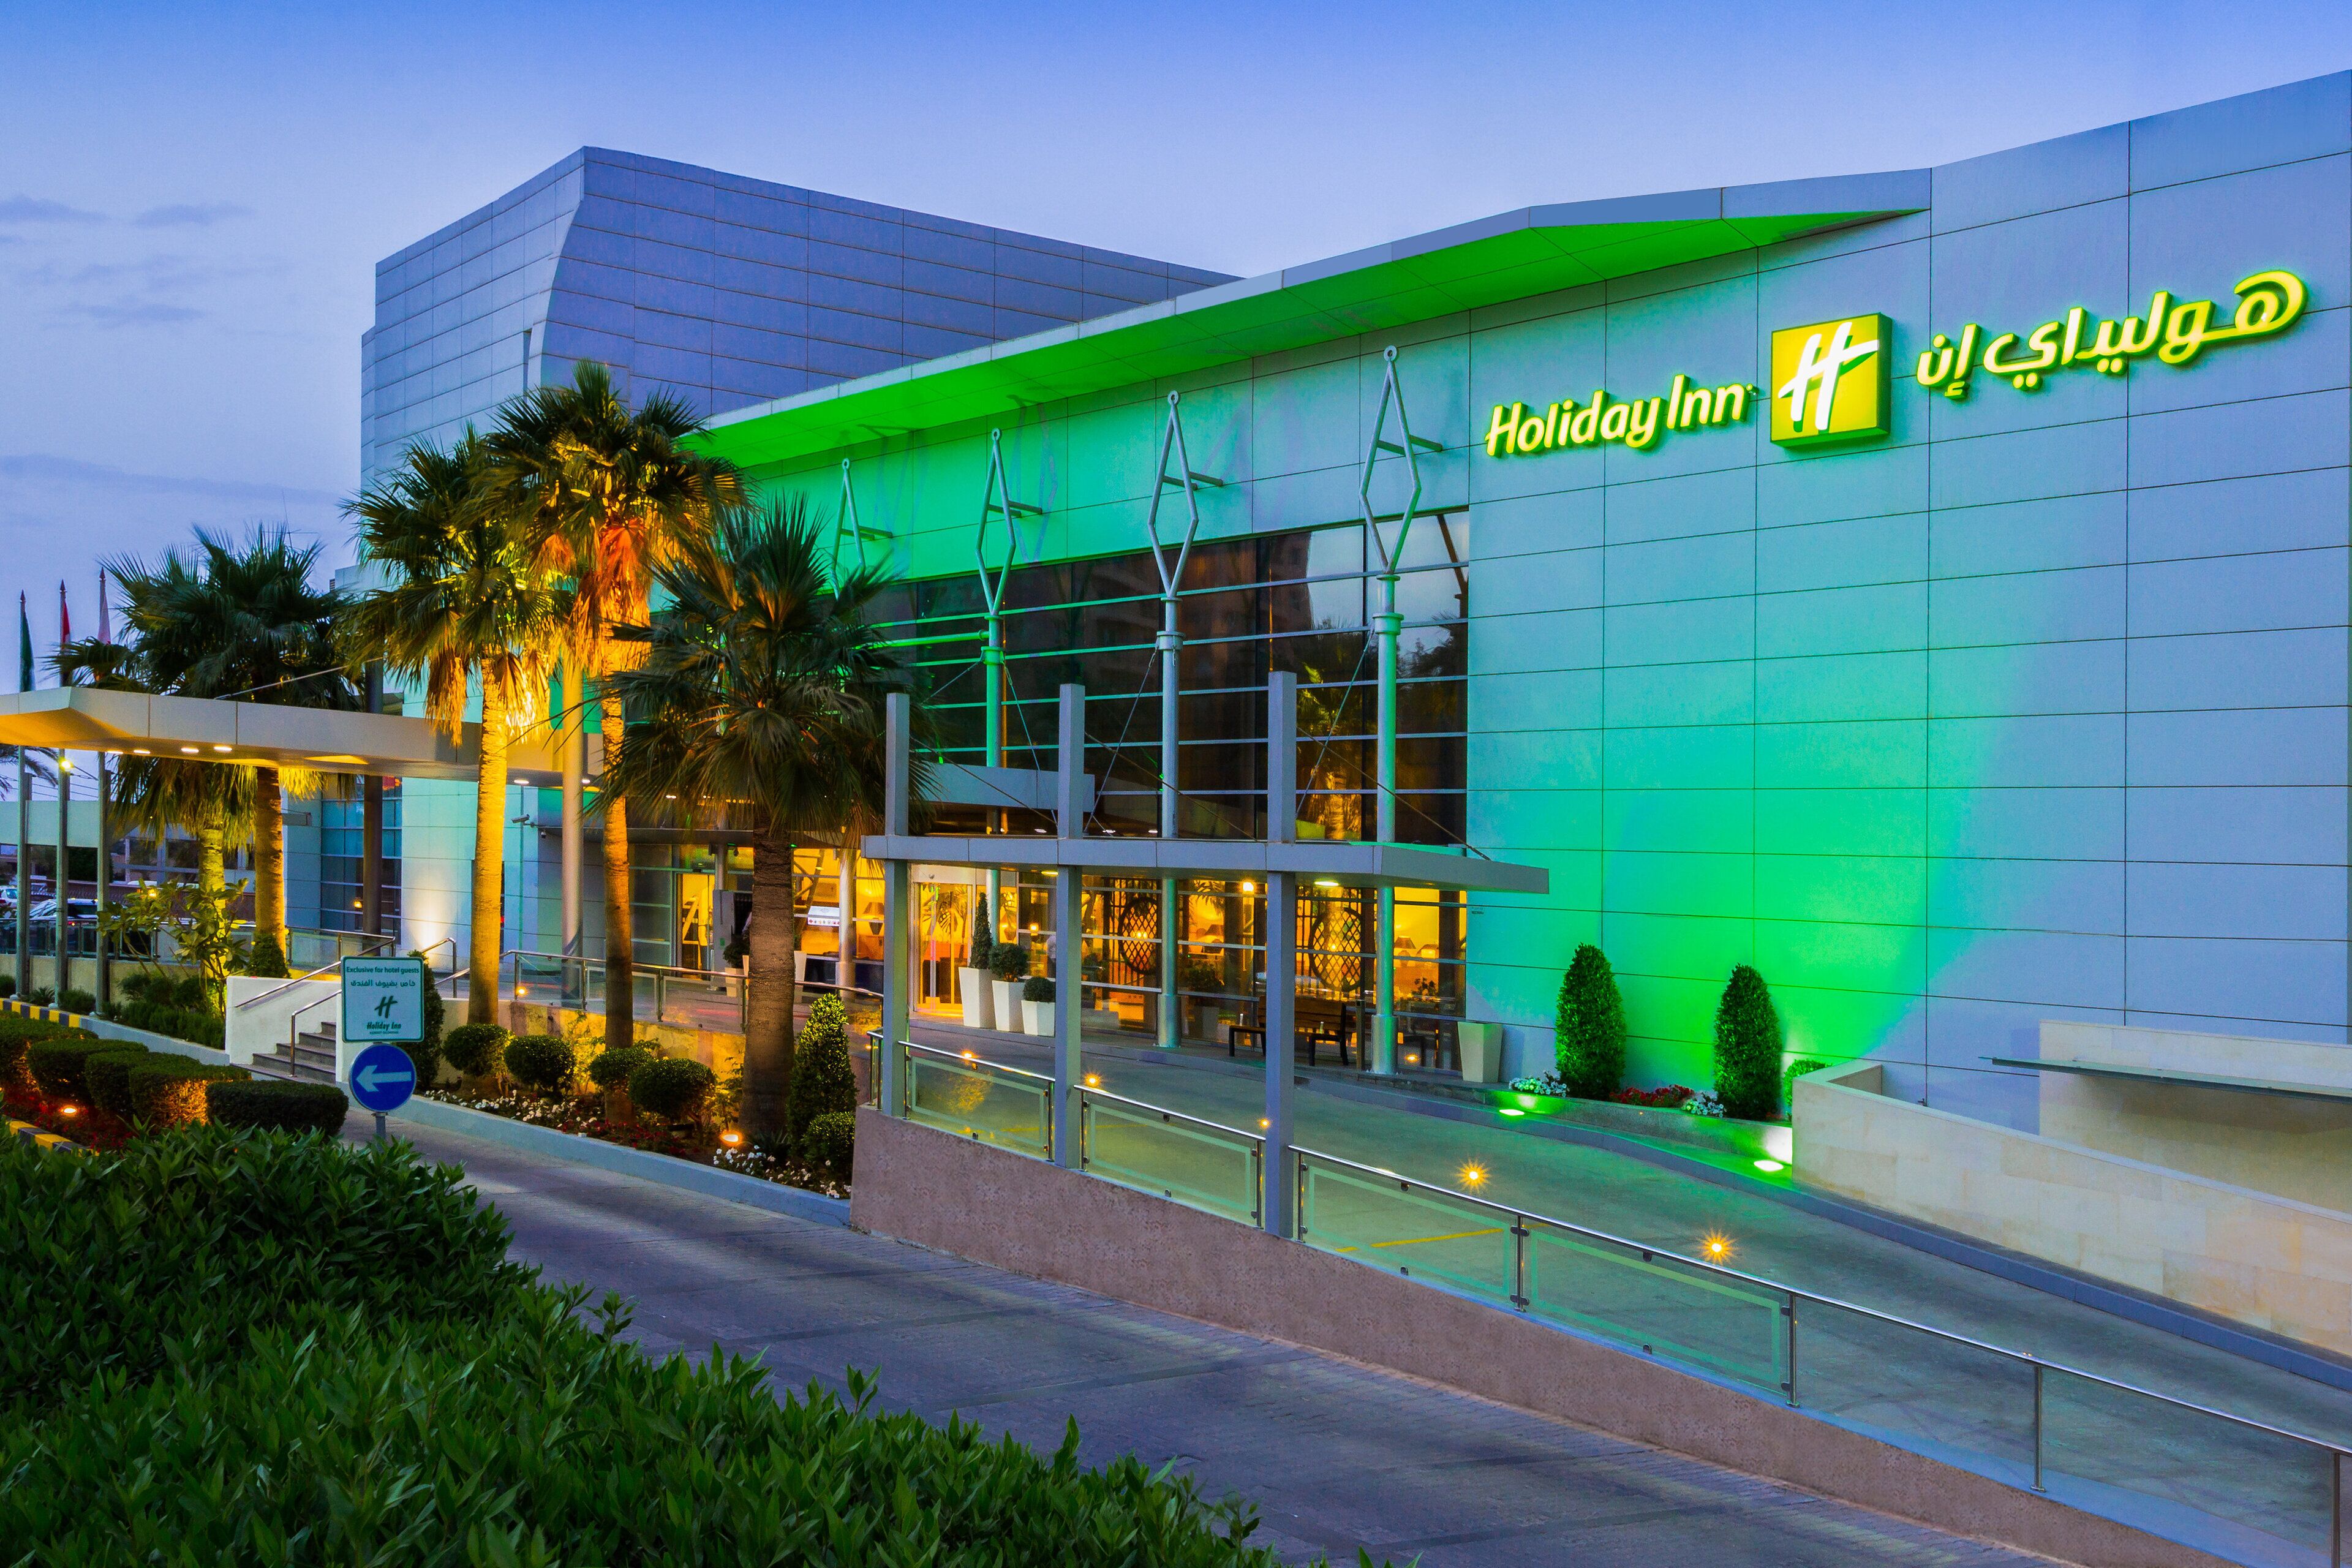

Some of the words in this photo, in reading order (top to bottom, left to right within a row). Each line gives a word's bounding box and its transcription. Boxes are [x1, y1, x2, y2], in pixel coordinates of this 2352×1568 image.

[1916, 323, 1981, 399] إن
[1983, 270, 2308, 390] هوليداي
[1485, 390, 1665, 457] Holiday
[1666, 374, 1748, 430] Inn
[367, 1022, 390, 1031] Holiday
